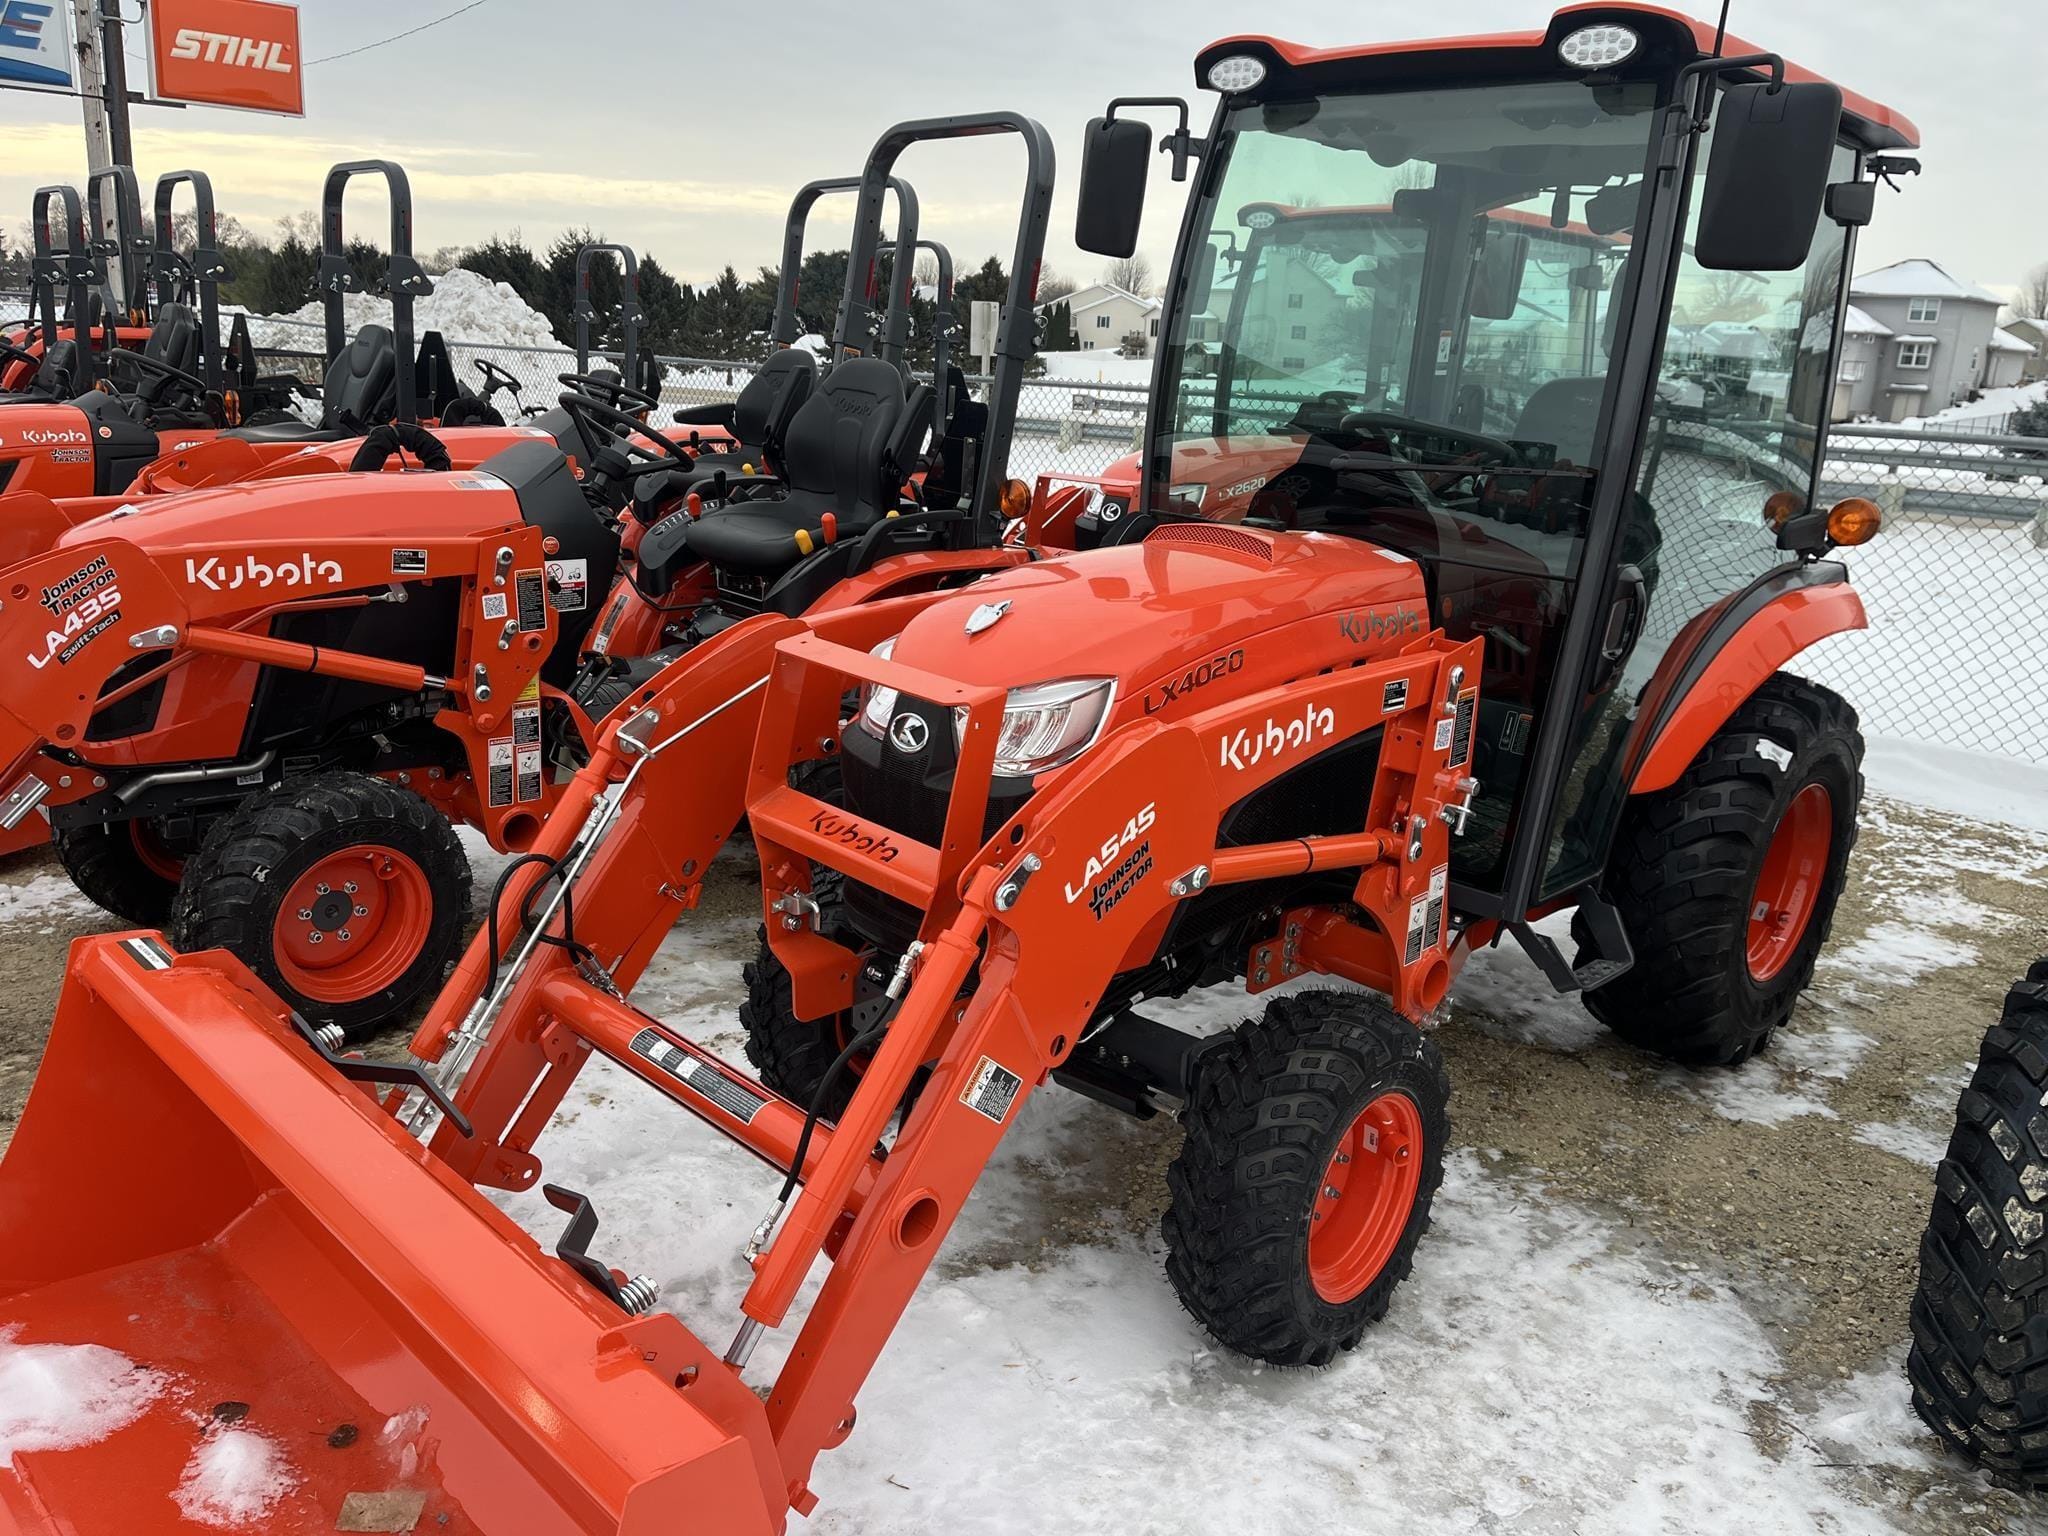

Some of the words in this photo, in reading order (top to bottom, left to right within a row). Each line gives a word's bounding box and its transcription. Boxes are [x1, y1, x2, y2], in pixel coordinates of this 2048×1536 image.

[170, 28, 292, 73] STIHL
[22, 429, 87, 443] Kubota
[40, 555, 107, 606] JOHNSON
[47, 568, 117, 617] TRACTOR
[185, 552, 343, 591] Kubota
[27, 585, 122, 669] LA435
[61, 613, 119, 662] Swift-Tach
[1338, 605, 1419, 643] Kubota
[1144, 649, 1245, 715] LX4020
[1220, 703, 1335, 771] Kubota
[809, 810, 899, 863] Kubota
[1064, 801, 1156, 904] LA545
[1089, 840, 1150, 909] JOHNSON
[1093, 857, 1153, 921] TRACTOR
